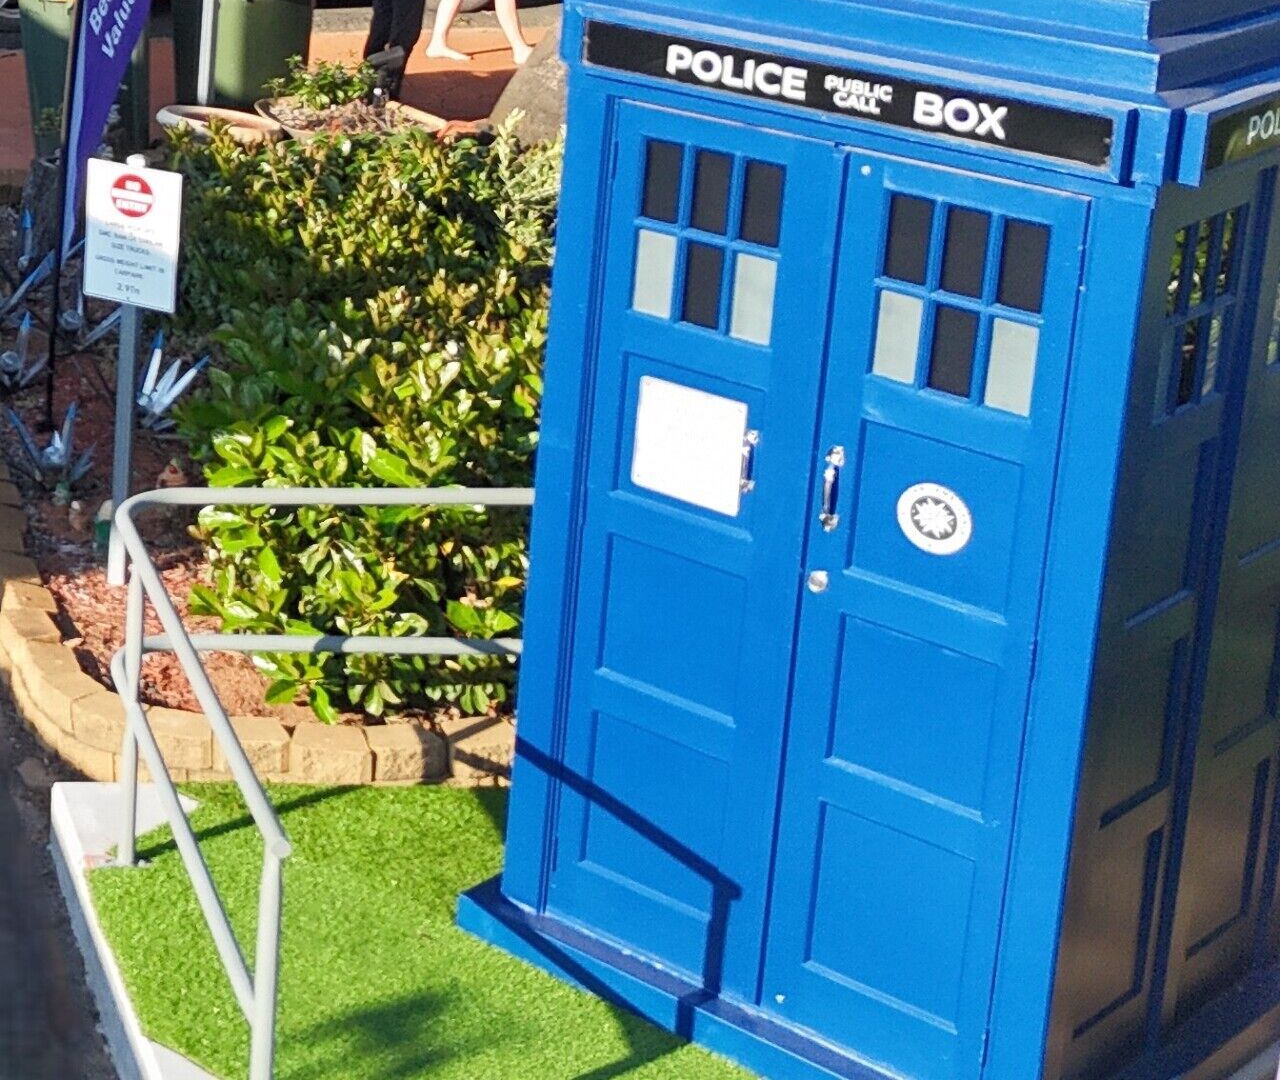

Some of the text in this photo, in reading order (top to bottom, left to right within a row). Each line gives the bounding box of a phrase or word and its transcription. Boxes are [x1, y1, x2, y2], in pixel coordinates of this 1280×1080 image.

[665, 44, 808, 102] POLICE
[824, 74, 893, 103] PUBLIC
[833, 91, 881, 116] CALL
[913, 91, 1008, 140] BOX
